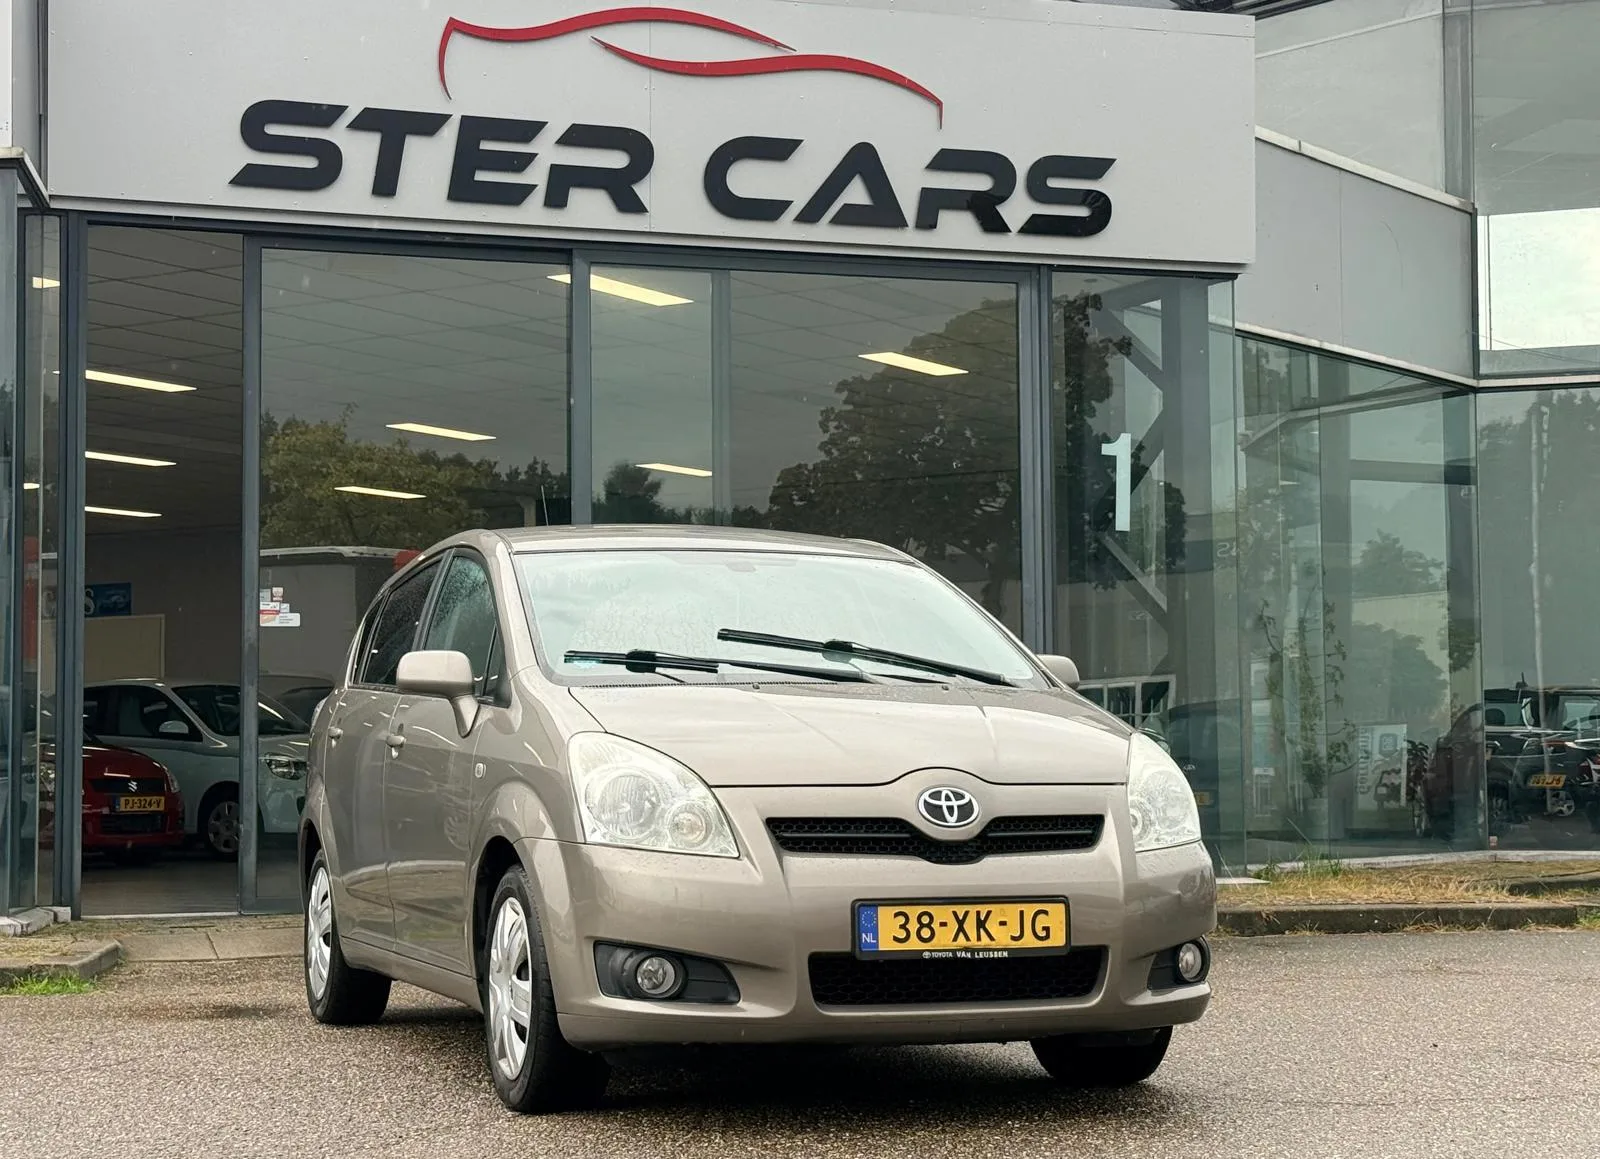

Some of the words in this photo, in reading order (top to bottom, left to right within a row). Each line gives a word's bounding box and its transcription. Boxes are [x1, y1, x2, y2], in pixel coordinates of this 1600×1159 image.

[228, 99, 655, 215] STER
[703, 136, 1117, 239] CARS
[1101, 432, 1132, 532] 1
[861, 932, 877, 944] NL
[892, 908, 1052, 944] 38-XK-JG
